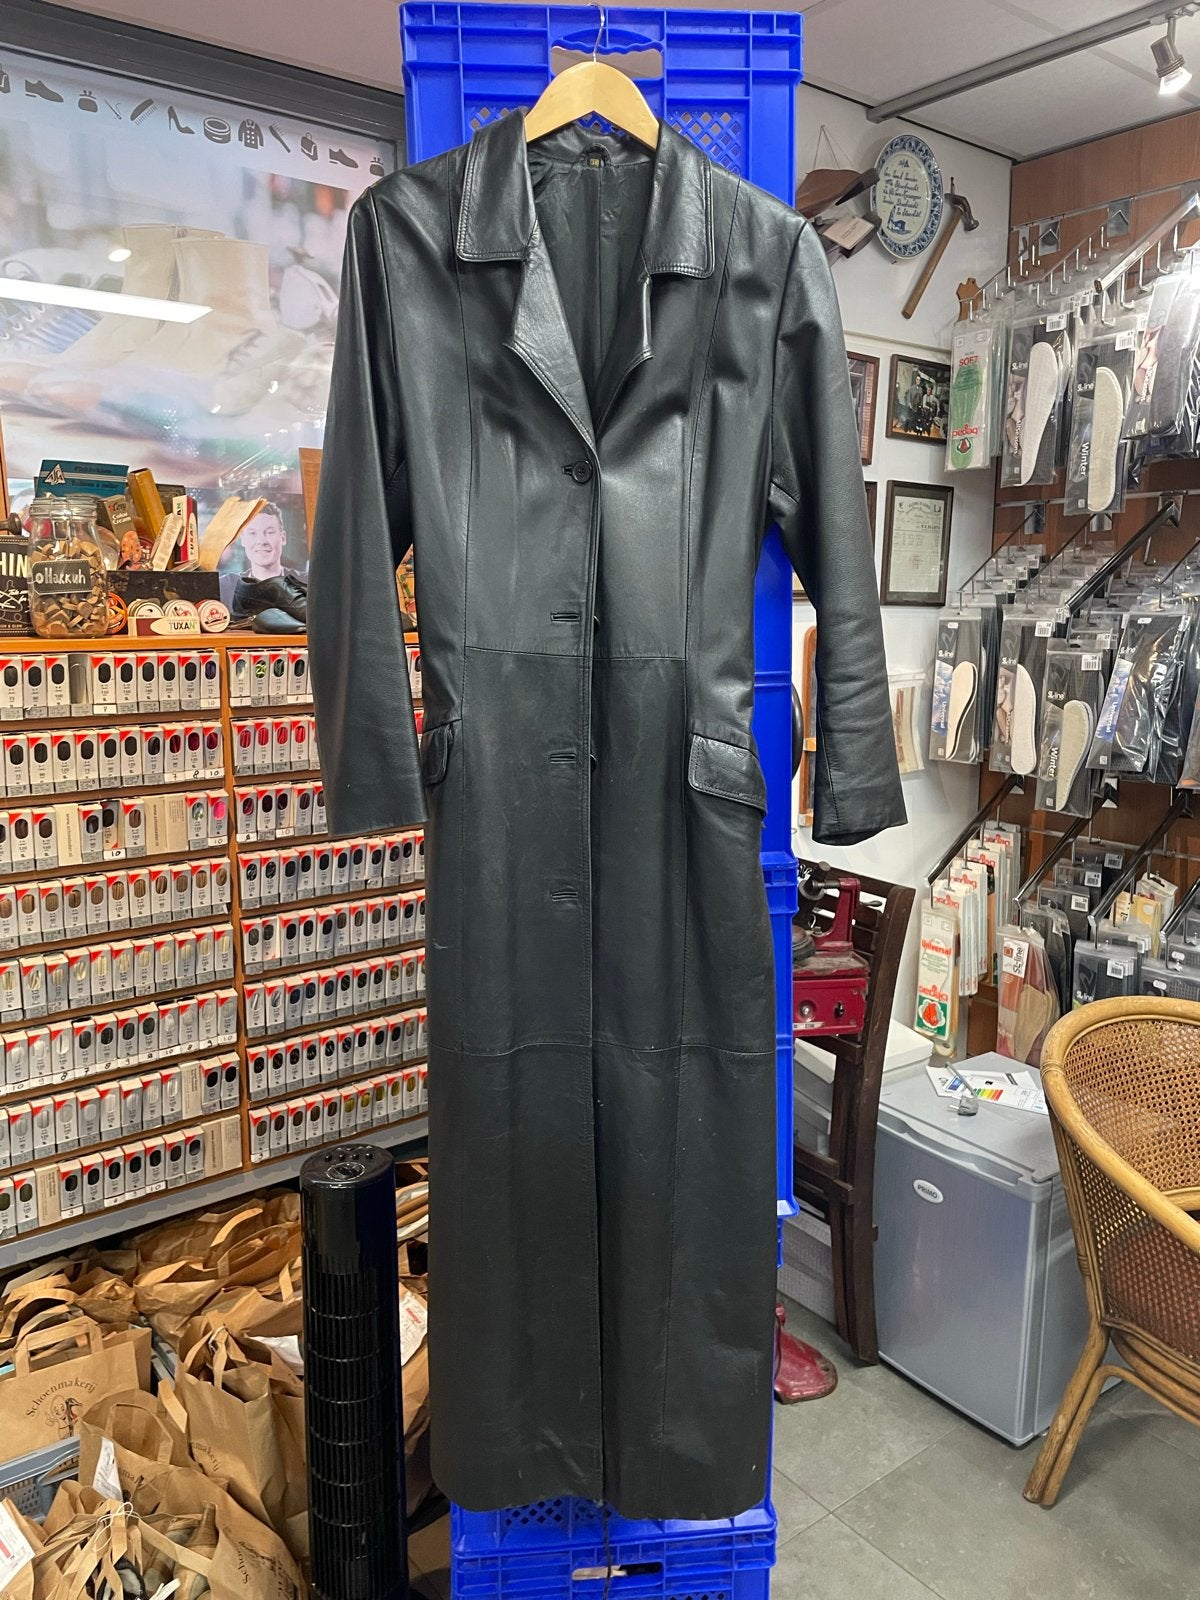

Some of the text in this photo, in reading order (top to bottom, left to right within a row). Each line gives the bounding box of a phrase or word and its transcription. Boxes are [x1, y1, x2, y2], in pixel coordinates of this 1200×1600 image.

[959, 355, 979, 366] SOFT
[1079, 442, 1090, 476] Winter
[112, 517, 131, 525] Cream
[169, 621, 196, 630] TUXAN
[1048, 748, 1059, 778] Winter
[193, 770, 199, 778] 8
[922, 939, 952, 956] Universal
[1013, 946, 1024, 974] SL-line
[917, 1184, 938, 1199] PRIMO
[26, 1377, 98, 1417] Schoenmakerij
